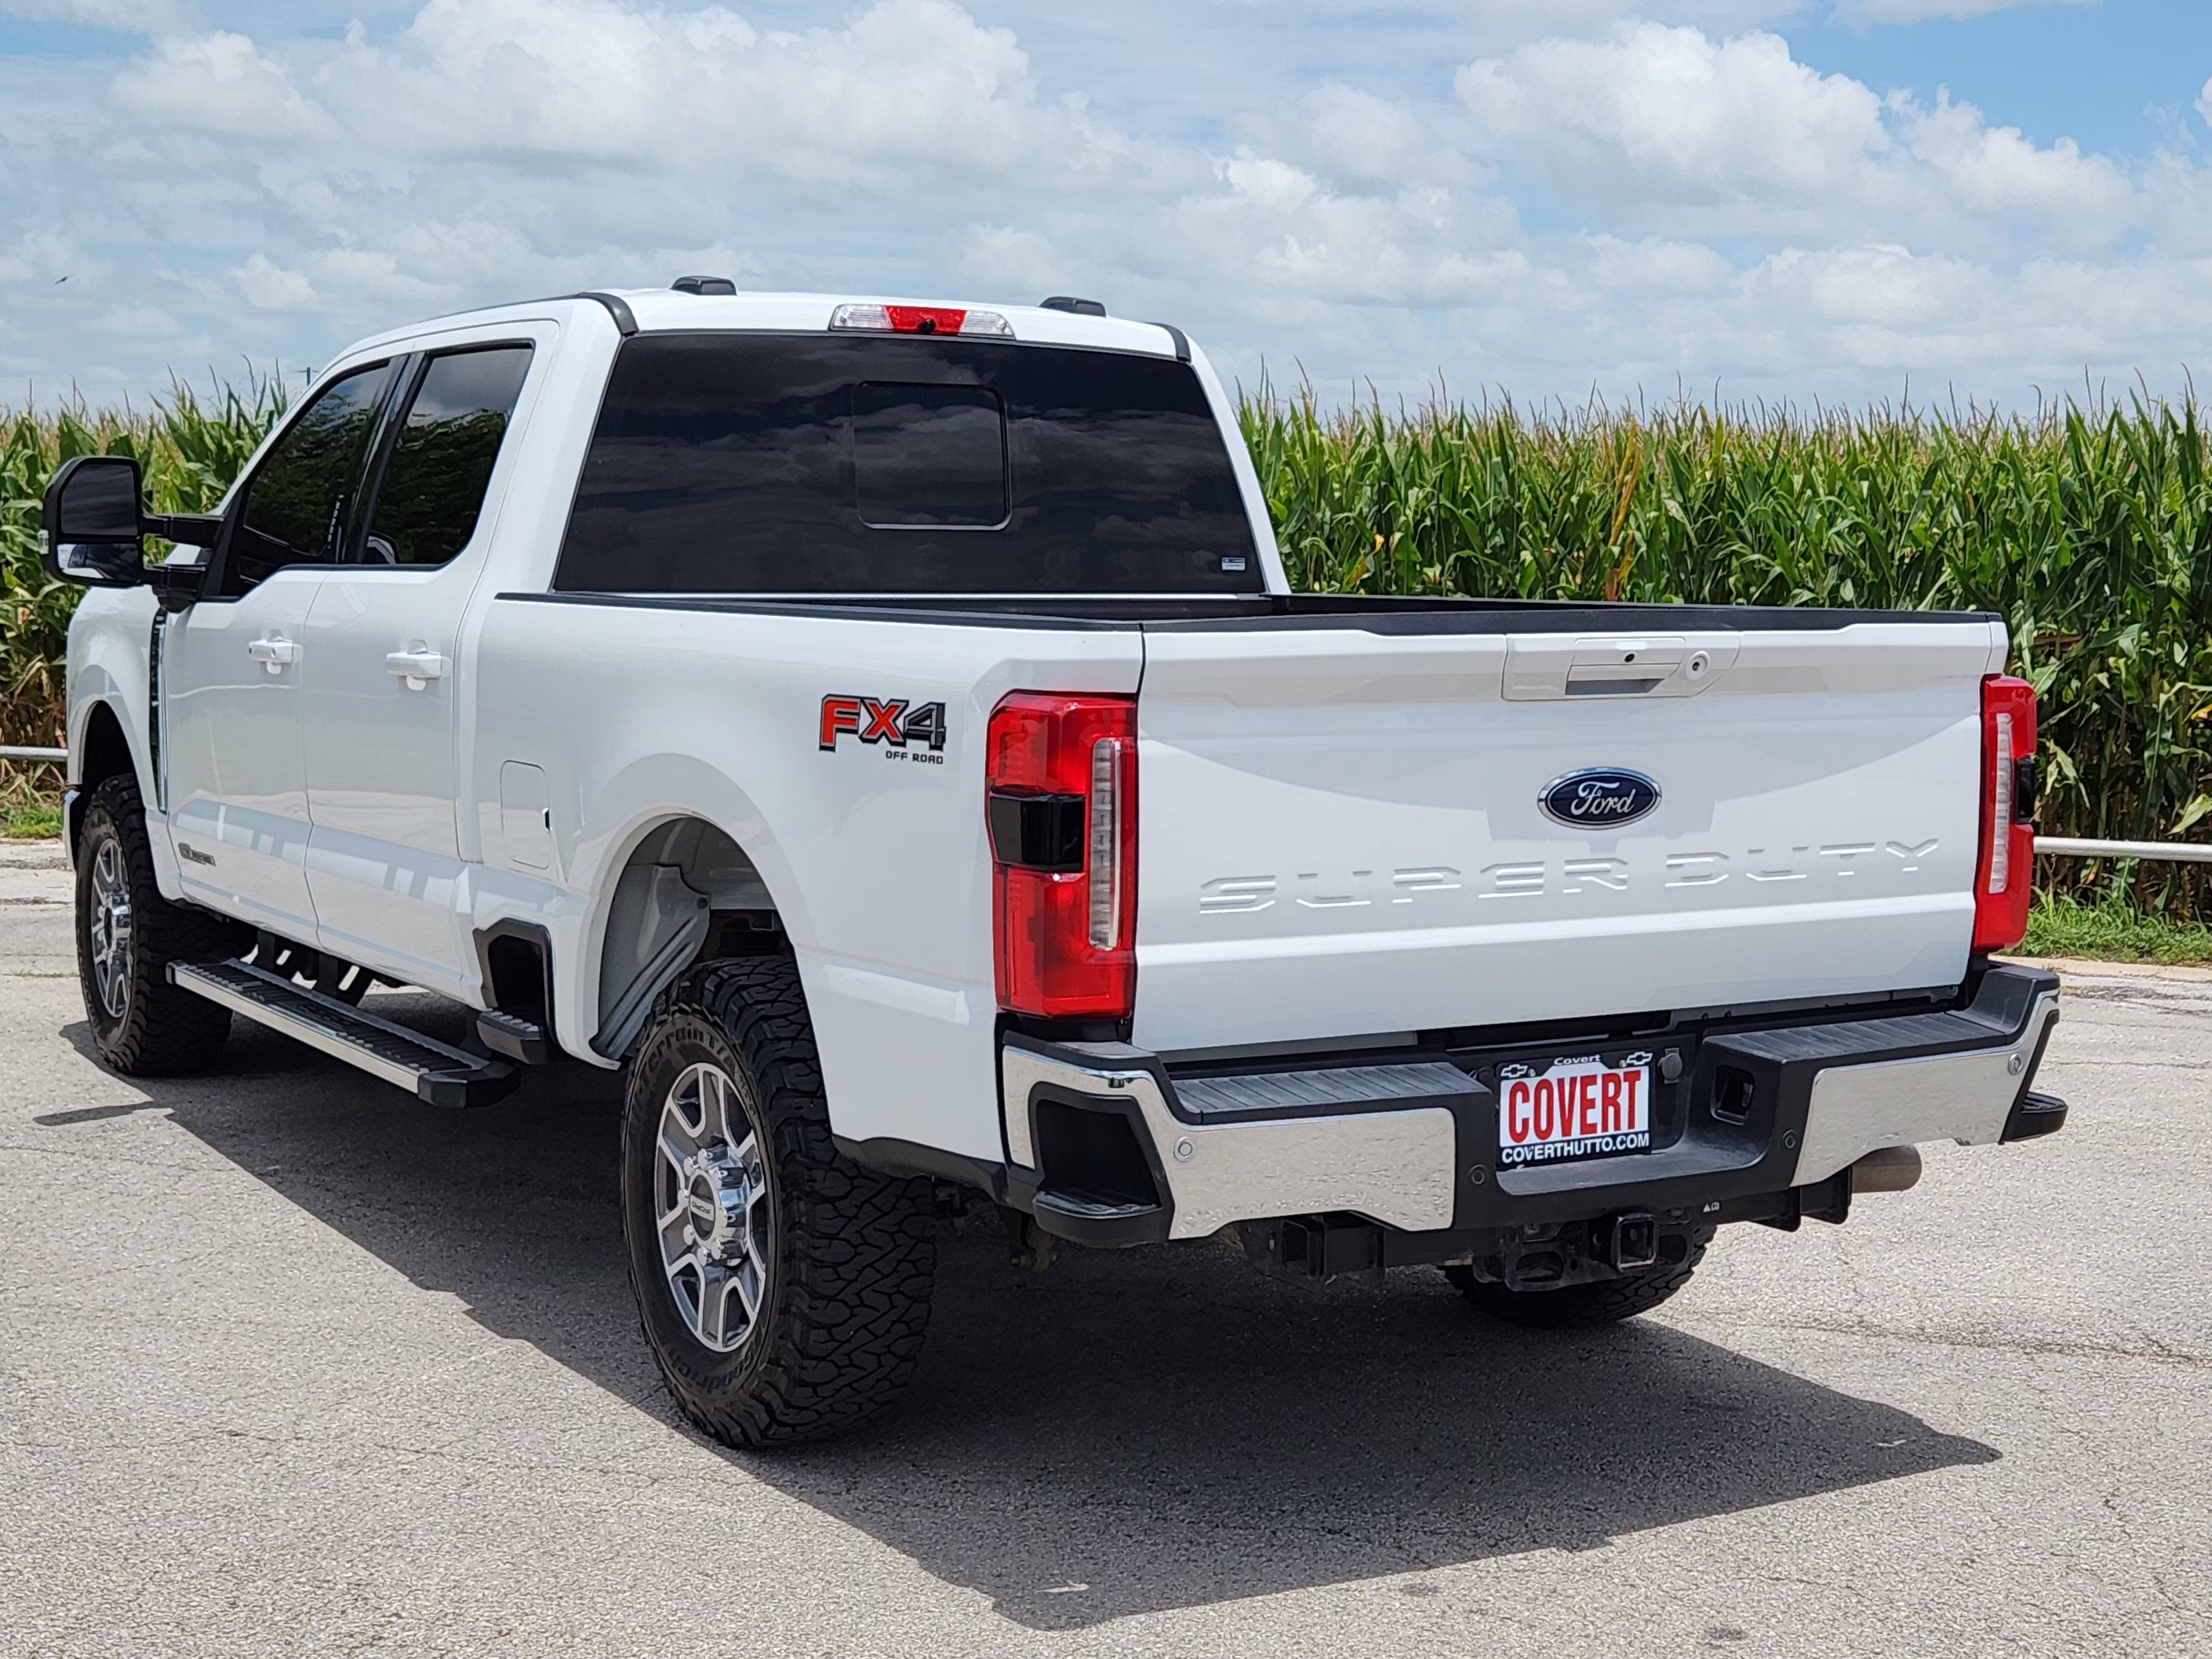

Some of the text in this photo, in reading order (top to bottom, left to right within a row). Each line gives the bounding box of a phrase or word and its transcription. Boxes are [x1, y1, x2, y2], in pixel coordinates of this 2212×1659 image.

[819, 693, 946, 753] FX4
[885, 750, 943, 765] OFF ROAD
[1571, 781, 1636, 816] Ford
[1199, 838, 1939, 914] SUPER DUTY
[1553, 1053, 1601, 1066] Covert
[1509, 1070, 1641, 1143] COVERT
[1502, 1133, 1650, 1164] COVERTHUTTO.COM
